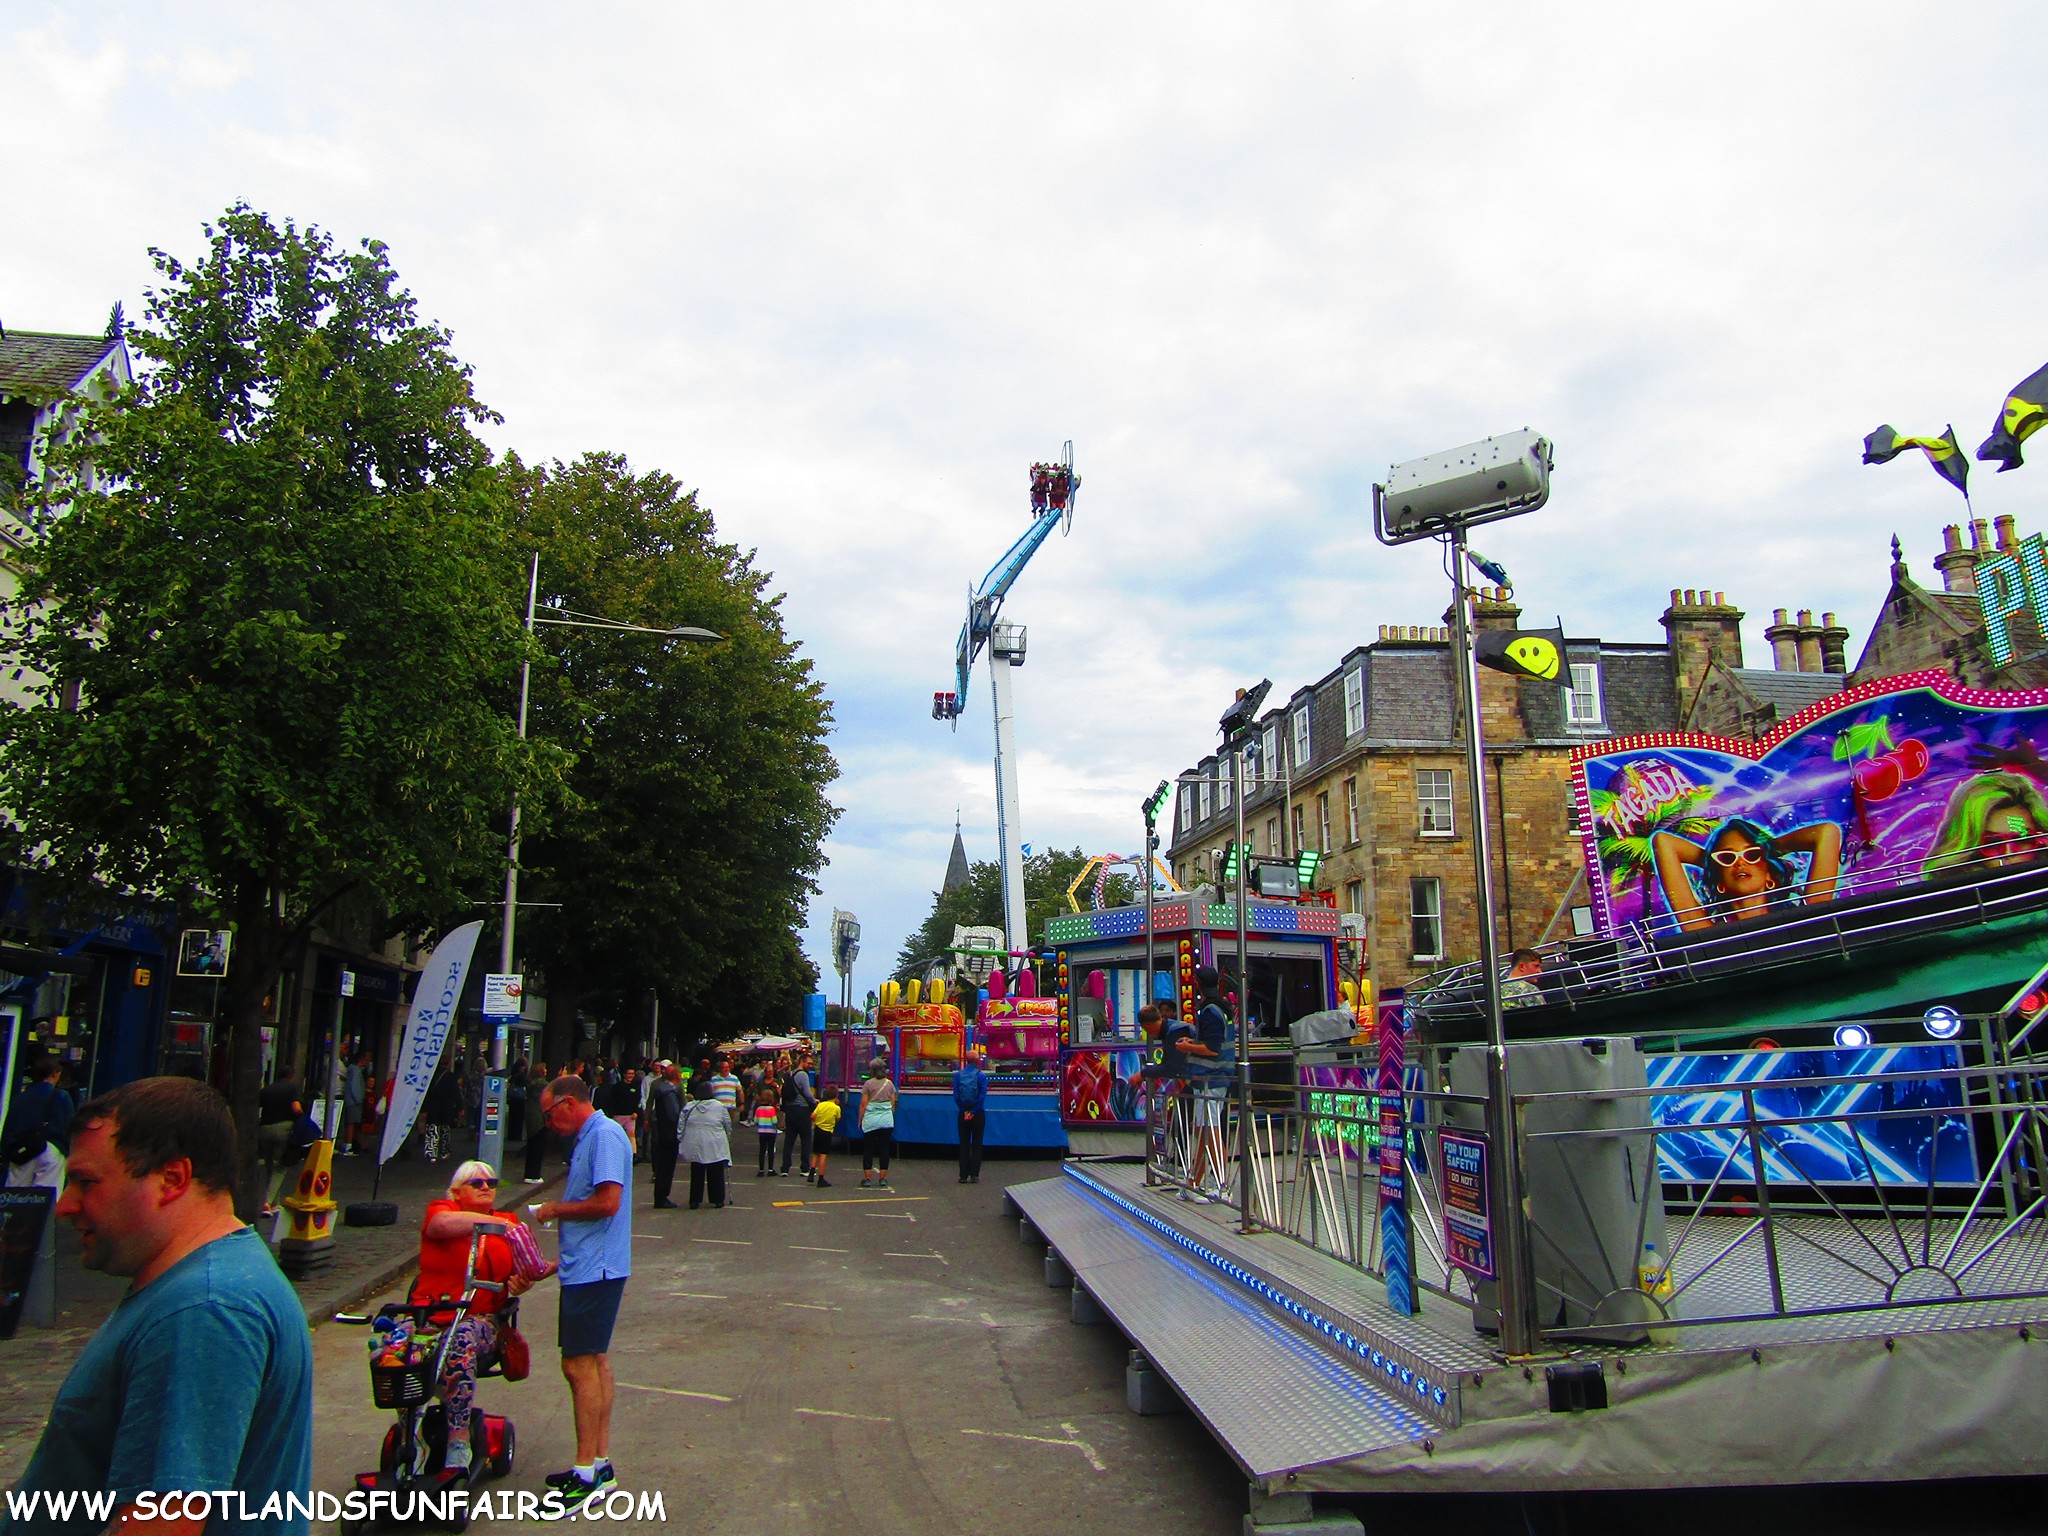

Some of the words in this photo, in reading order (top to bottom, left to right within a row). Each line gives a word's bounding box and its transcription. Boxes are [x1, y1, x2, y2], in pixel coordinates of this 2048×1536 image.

[1603, 767, 1702, 840] TAGADA
[1180, 939, 1192, 982] PAY
[1058, 951, 1069, 990] PAY
[1181, 985, 1194, 1025] HER
[1059, 993, 1071, 1045] HERE
[491, 1078, 499, 1090] P
[1379, 1089, 1400, 1097] CHILDREN
[1443, 1141, 1456, 1153] FOR
[1459, 1145, 1480, 1160] YOUR
[1446, 1155, 1478, 1173] SAFETY!
[1451, 1172, 1459, 1182] DO
[1460, 1175, 1473, 1187] NOT
[1380, 1185, 1402, 1199] TAGADA
